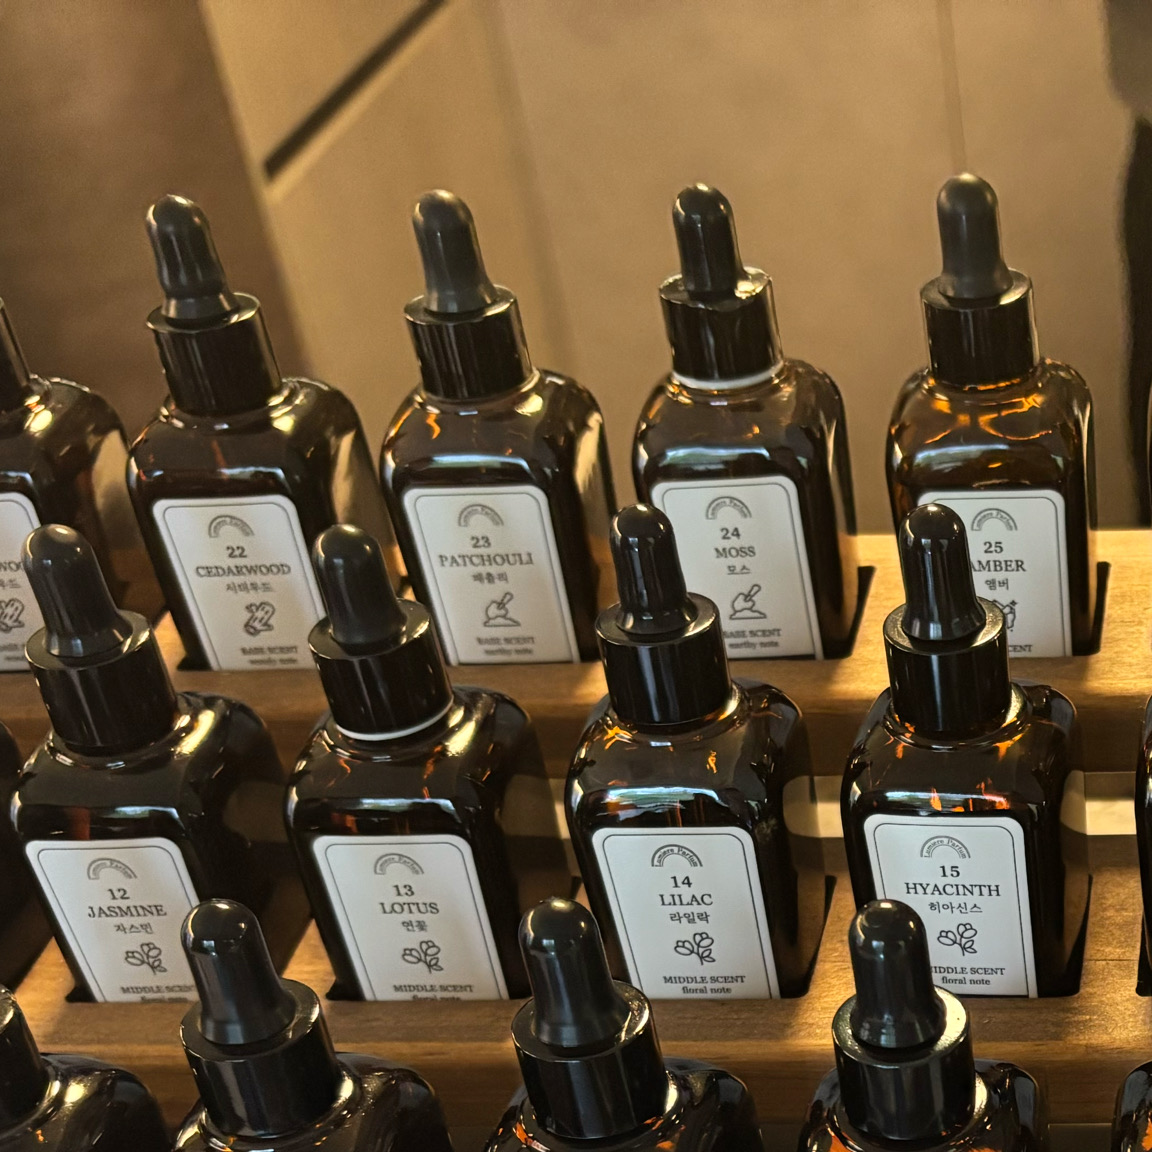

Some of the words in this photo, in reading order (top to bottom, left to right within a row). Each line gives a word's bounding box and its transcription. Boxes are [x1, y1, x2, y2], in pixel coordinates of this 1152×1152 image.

[720, 528, 740, 539] 24
[471, 536, 491, 548] 23
[984, 542, 1003, 553] 25
[226, 546, 247, 558] 22
[715, 546, 755, 558] MOSS
[439, 553, 534, 567] PATCHOULI
[196, 564, 291, 577] CEDARWOOD
[727, 565, 751, 575] 모스
[985, 579, 1009, 590] 앰버
[940, 866, 960, 877] 15
[671, 876, 692, 888] 14
[107, 889, 130, 900] 12
[393, 885, 414, 897] 13
[905, 883, 1000, 896] HYACINTH
[659, 894, 713, 906] LILAC
[88, 905, 167, 918] JASMINE
[380, 902, 439, 914] LOTUS
[929, 902, 983, 914] 히아신스
[670, 912, 710, 924] 라일락
[115, 923, 153, 934] 자스민
[402, 921, 427, 932] 연꽃
[663, 976, 708, 984] MIDDLE
